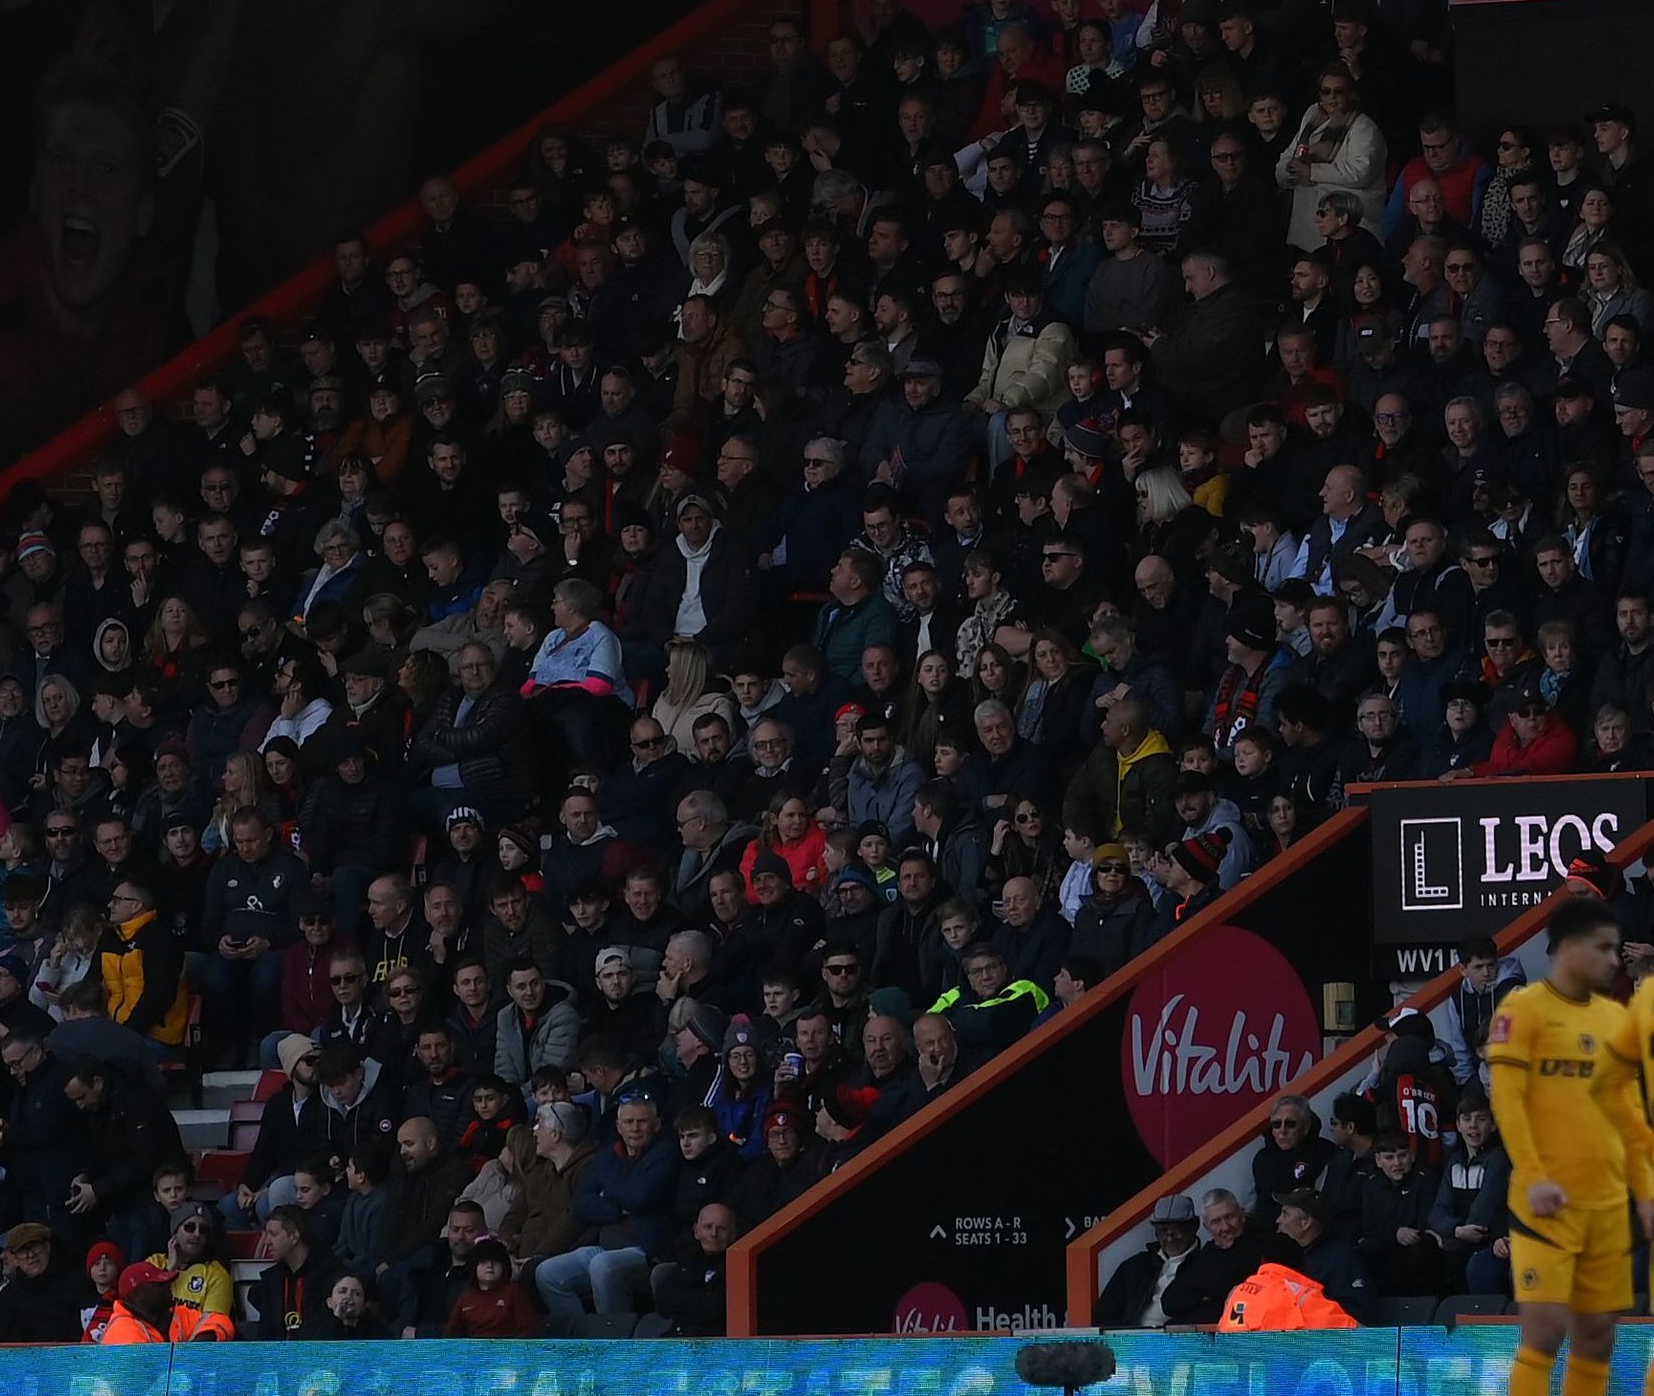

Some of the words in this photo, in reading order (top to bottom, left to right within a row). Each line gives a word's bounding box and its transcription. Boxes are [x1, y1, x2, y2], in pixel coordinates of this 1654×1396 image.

[1480, 813, 1620, 883] LEOS
[1481, 891, 1552, 907] INTERN
[1402, 1099, 1440, 1140] 10
[955, 1217, 992, 1230] ROWS
[994, 1218, 1004, 1230] A
[1012, 1217, 1021, 1229] R
[955, 1232, 992, 1245] SEATS
[995, 1232, 1001, 1244] 1
[1012, 1231, 1027, 1244] 33
[977, 1304, 1056, 1332] Health
